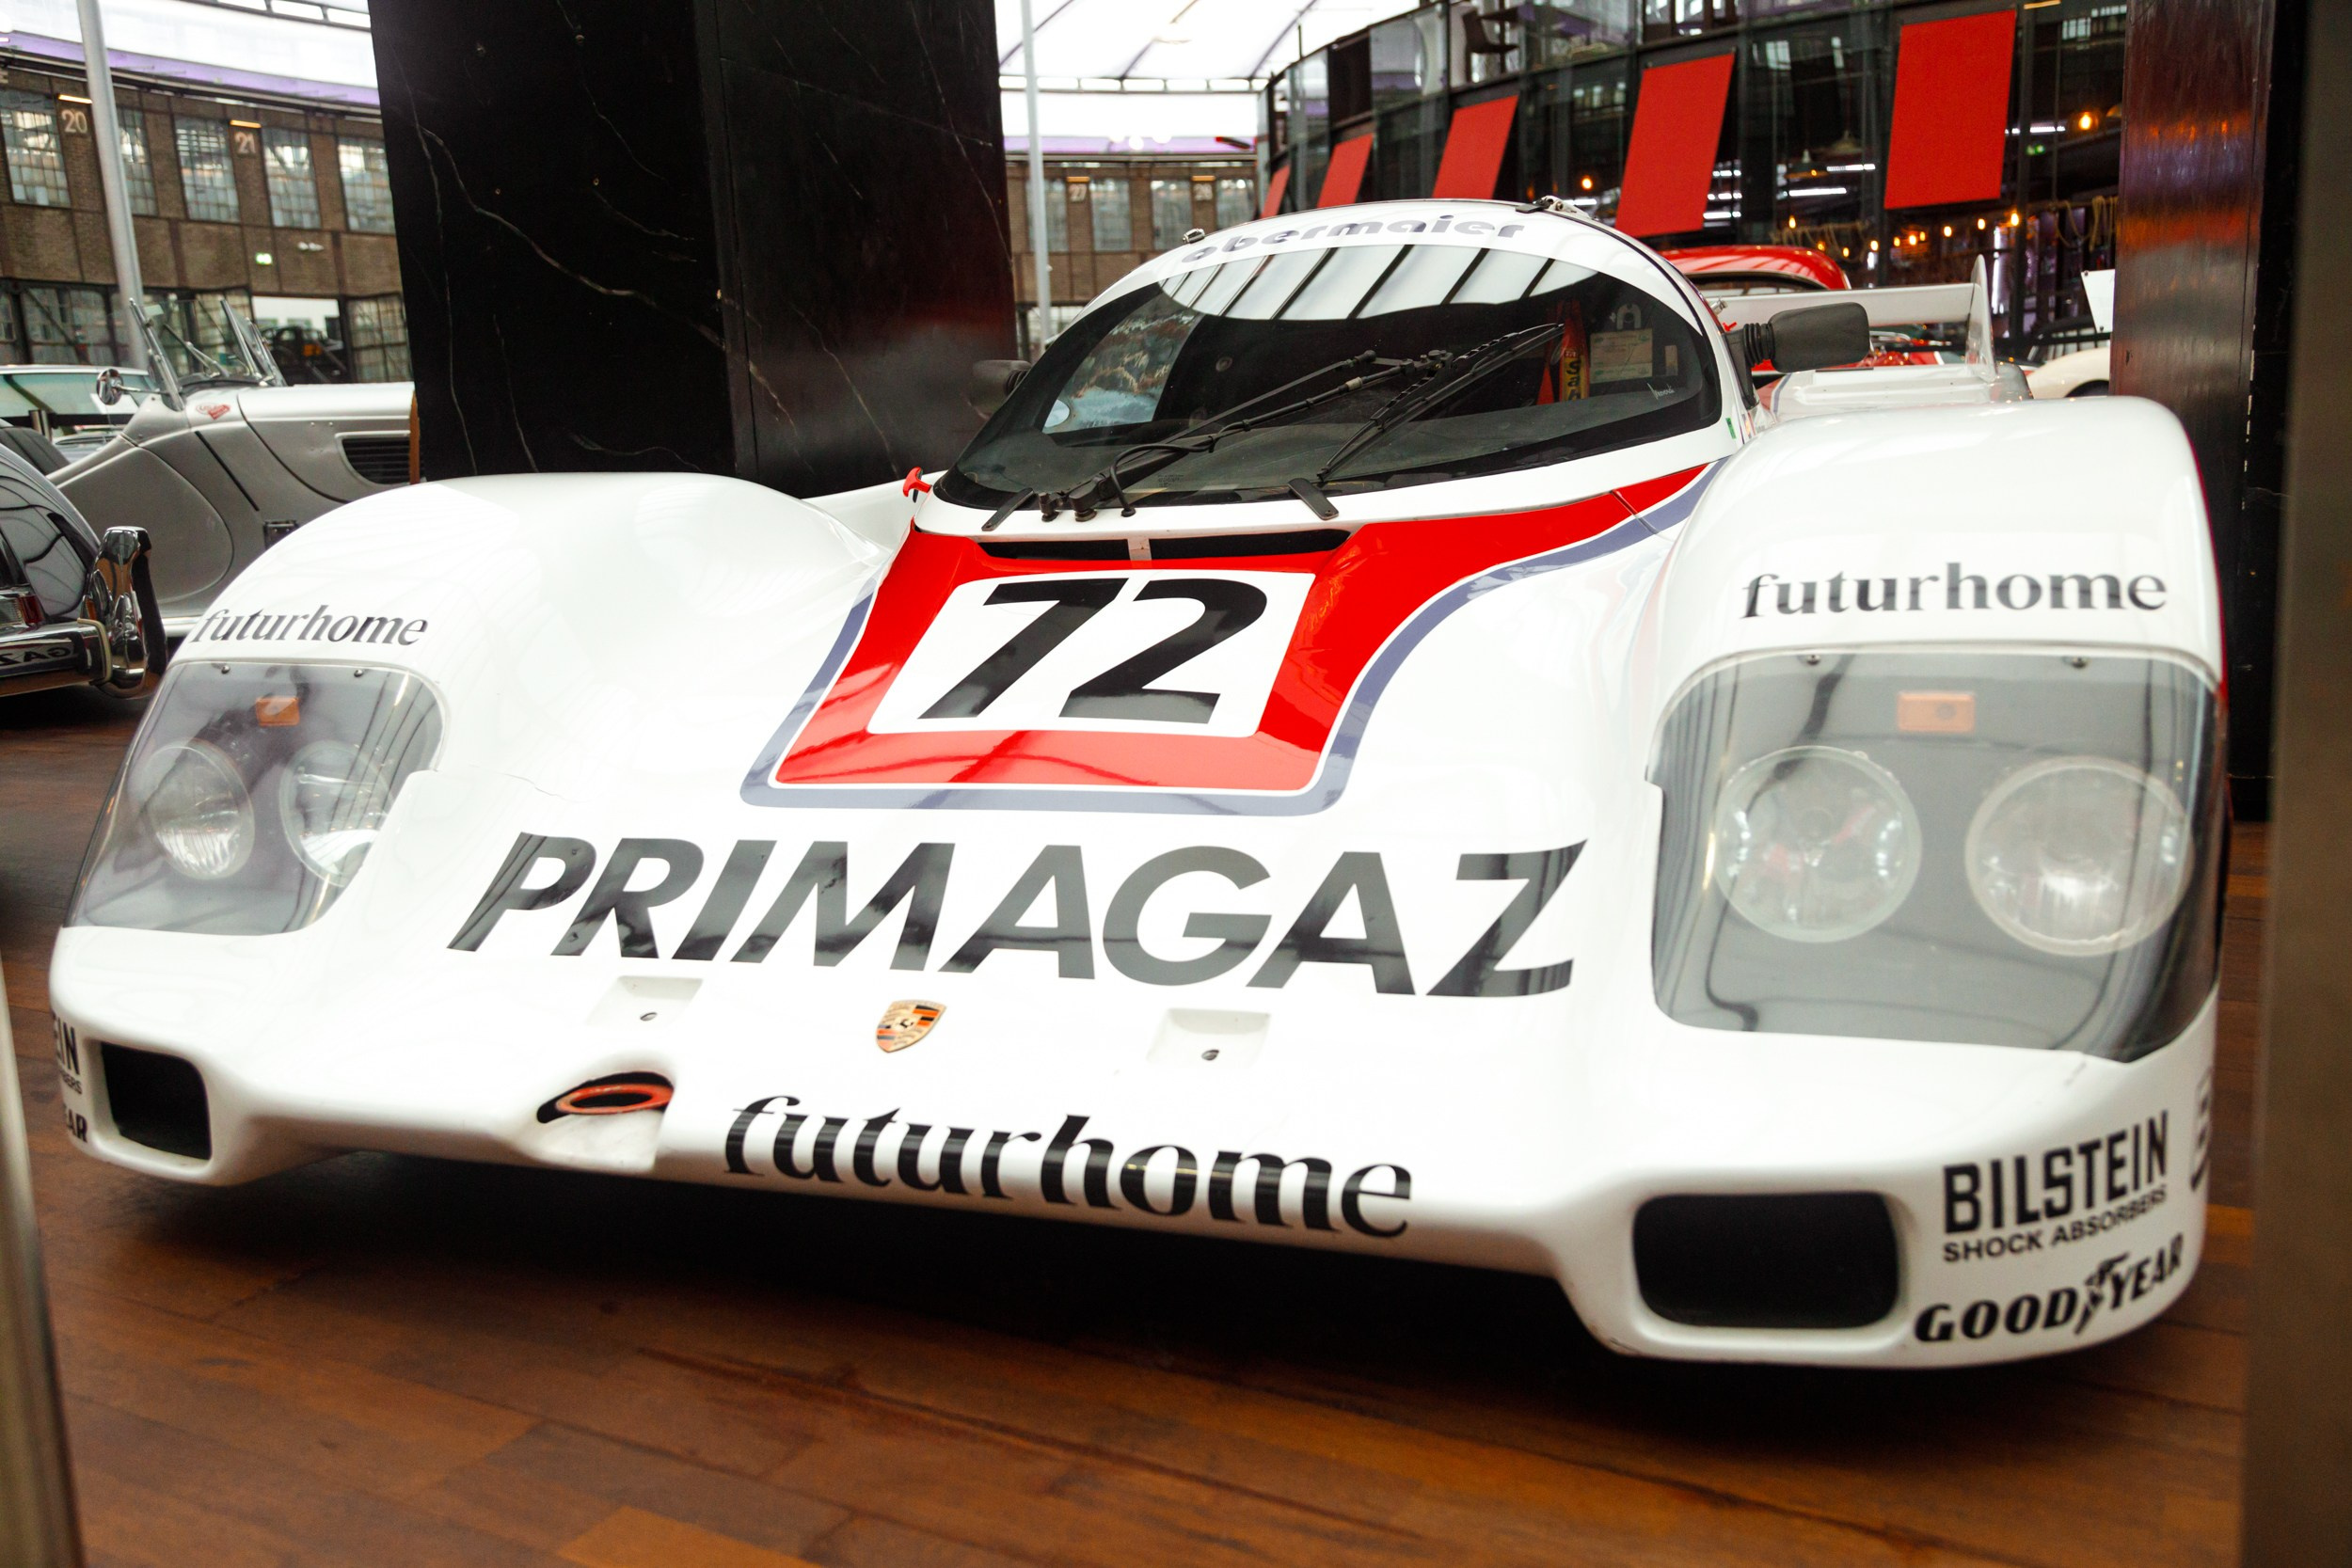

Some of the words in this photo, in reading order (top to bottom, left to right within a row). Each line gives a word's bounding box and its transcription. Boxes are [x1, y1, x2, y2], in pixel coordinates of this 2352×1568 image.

[61, 109, 88, 134] 20
[235, 132, 256, 154] 21
[1181, 214, 1525, 263] obermaier
[1742, 562, 2169, 619] futurhome
[191, 605, 429, 646] futurhome
[917, 577, 1268, 725] 72
[447, 832, 1588, 998] PRIMAGAZ
[724, 1094, 1414, 1239] futurhome
[1944, 1110, 2168, 1235] BILSTEIN
[1944, 1230, 2042, 1262] SHOCK
[2050, 1184, 2167, 1246] ABSORBERS
